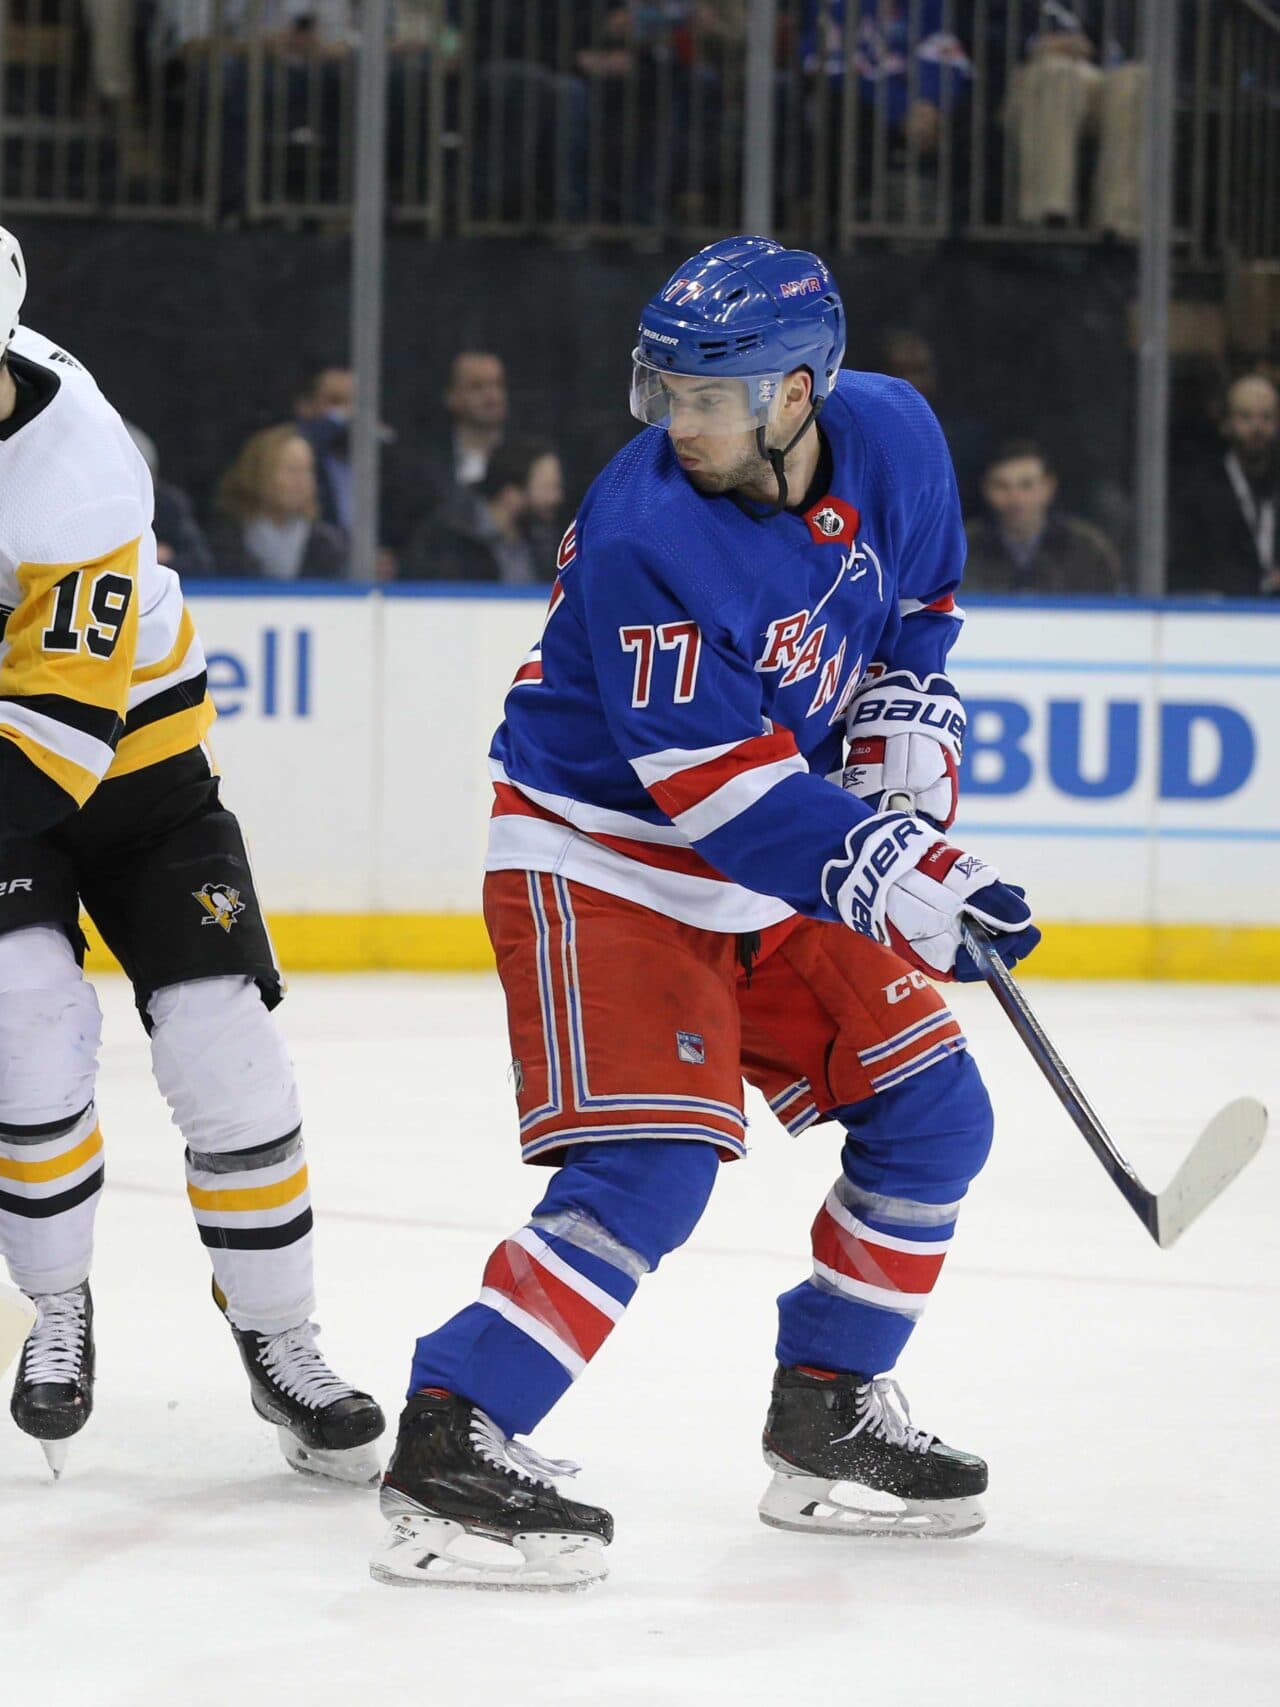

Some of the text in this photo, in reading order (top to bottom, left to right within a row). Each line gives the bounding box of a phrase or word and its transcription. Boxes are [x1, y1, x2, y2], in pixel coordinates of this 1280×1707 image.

[664, 279, 705, 306] 77
[779, 276, 821, 299] NYR
[643, 328, 680, 346] BAUER
[41, 569, 133, 660] 19
[619, 620, 701, 708] 77
[852, 699, 966, 742] BAUE
[959, 699, 1256, 798] BUD
[881, 969, 928, 1004] CC
